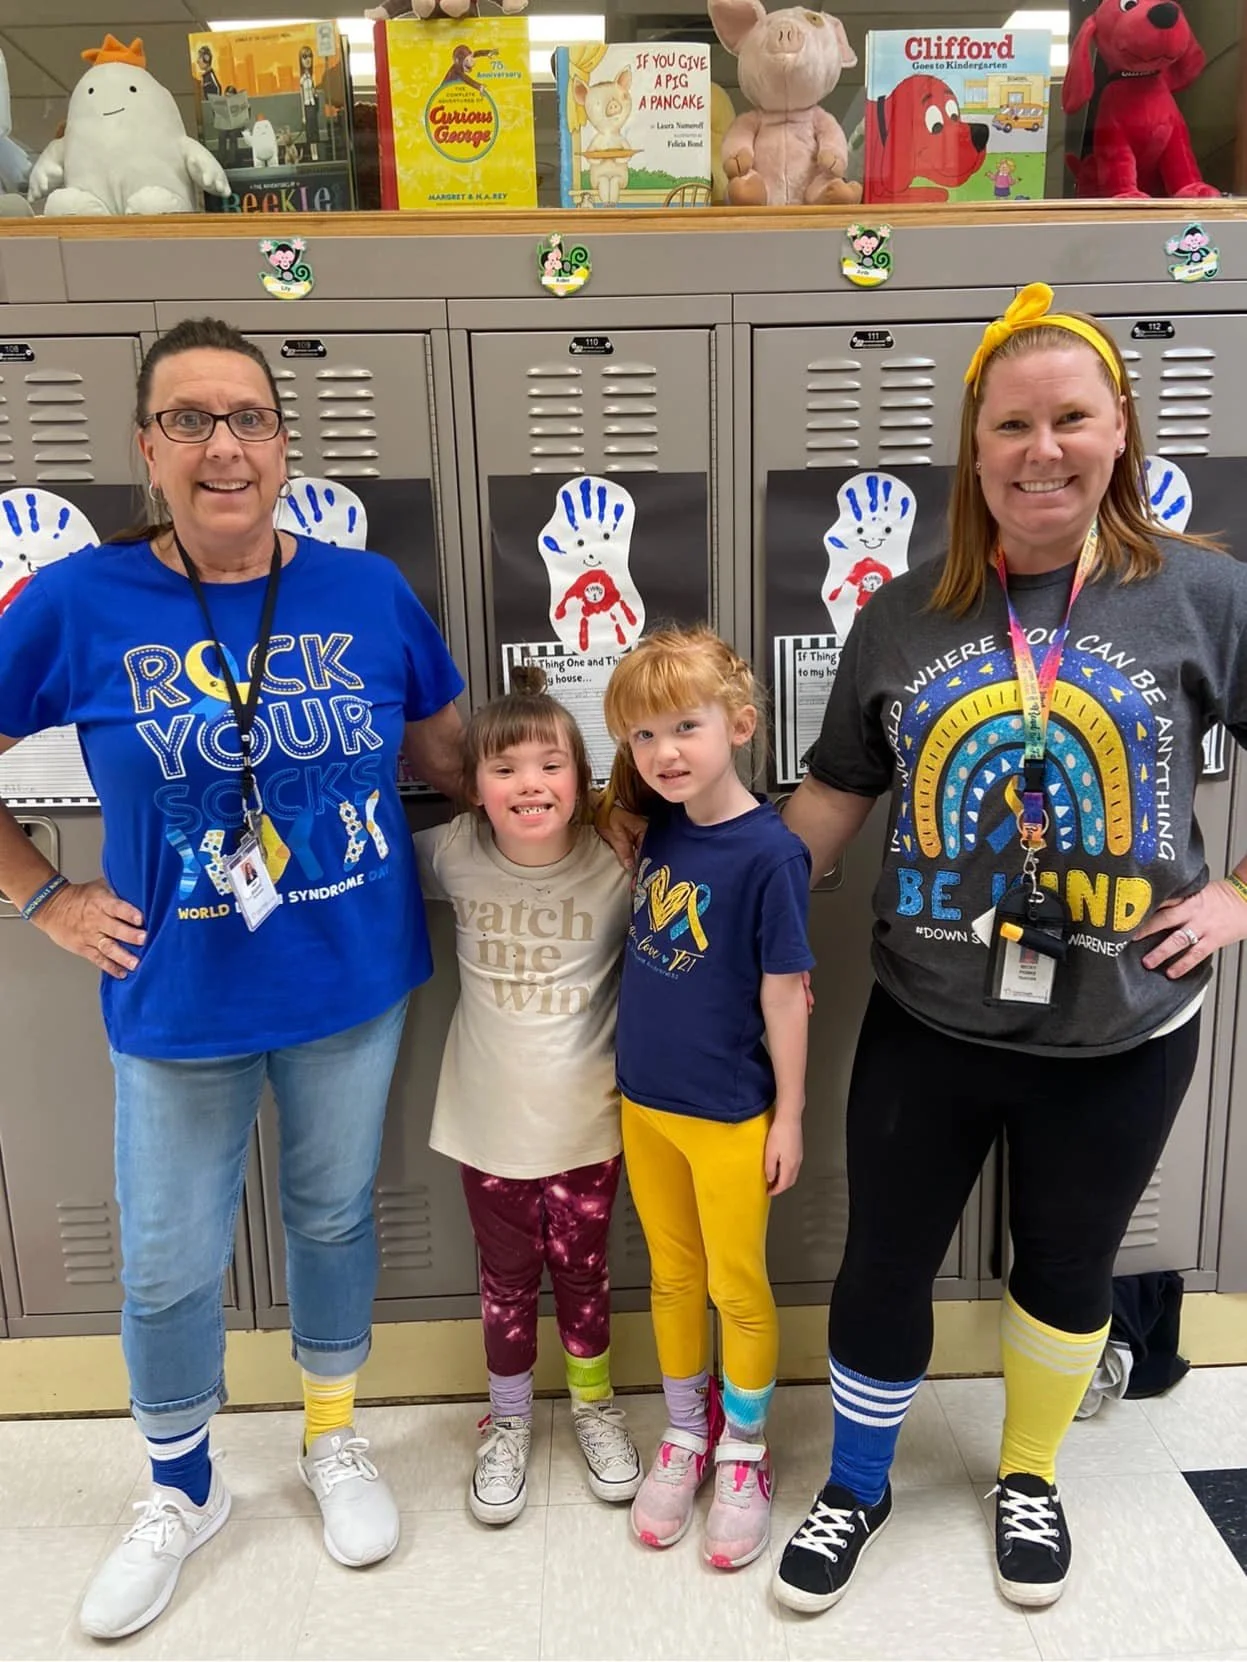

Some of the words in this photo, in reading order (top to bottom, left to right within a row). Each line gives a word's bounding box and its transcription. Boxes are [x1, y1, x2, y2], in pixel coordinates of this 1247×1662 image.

[904, 33, 1015, 61] Clifford
[636, 53, 649, 70] IF
[652, 52, 675, 69] YOU
[678, 55, 708, 71] GIVE
[912, 62, 934, 71] Goes
[935, 62, 945, 70] to
[946, 61, 1008, 71] Kindergarten
[654, 75, 663, 89] A
[665, 73, 689, 90] PIG
[638, 96, 647, 111] A
[650, 94, 705, 111] PANCAKE
[429, 106, 493, 125] Curious
[657, 121, 675, 130] Laura
[434, 125, 491, 149] George
[1148, 322, 1161, 331] 112
[586, 338, 599, 346] 110
[868, 332, 879, 340] 111
[538, 659, 565, 673] Thing
[566, 658, 585, 668] One
[587, 657, 604, 667] and
[605, 656, 622, 666] Thi
[798, 652, 807, 662] If
[810, 652, 837, 666] Thing
[798, 669, 808, 677] to
[810, 669, 824, 678] my
[136, 695, 383, 780] YOUR
[904, 634, 997, 695] WHERE
[1007, 628, 1070, 645] OU
[1075, 634, 1136, 669] CAN
[1129, 669, 1167, 706] BE
[1154, 715, 1176, 861] ANYTHING
[153, 754, 382, 836] SOCKS
[288, 873, 365, 904] SYNDROME
[896, 867, 962, 922] BE
[177, 903, 230, 921] WORLD
[916, 926, 968, 943] #DOWN
[1067, 933, 1128, 957] WARENES
[475, 939, 562, 981] me
[489, 976, 592, 1015] win
